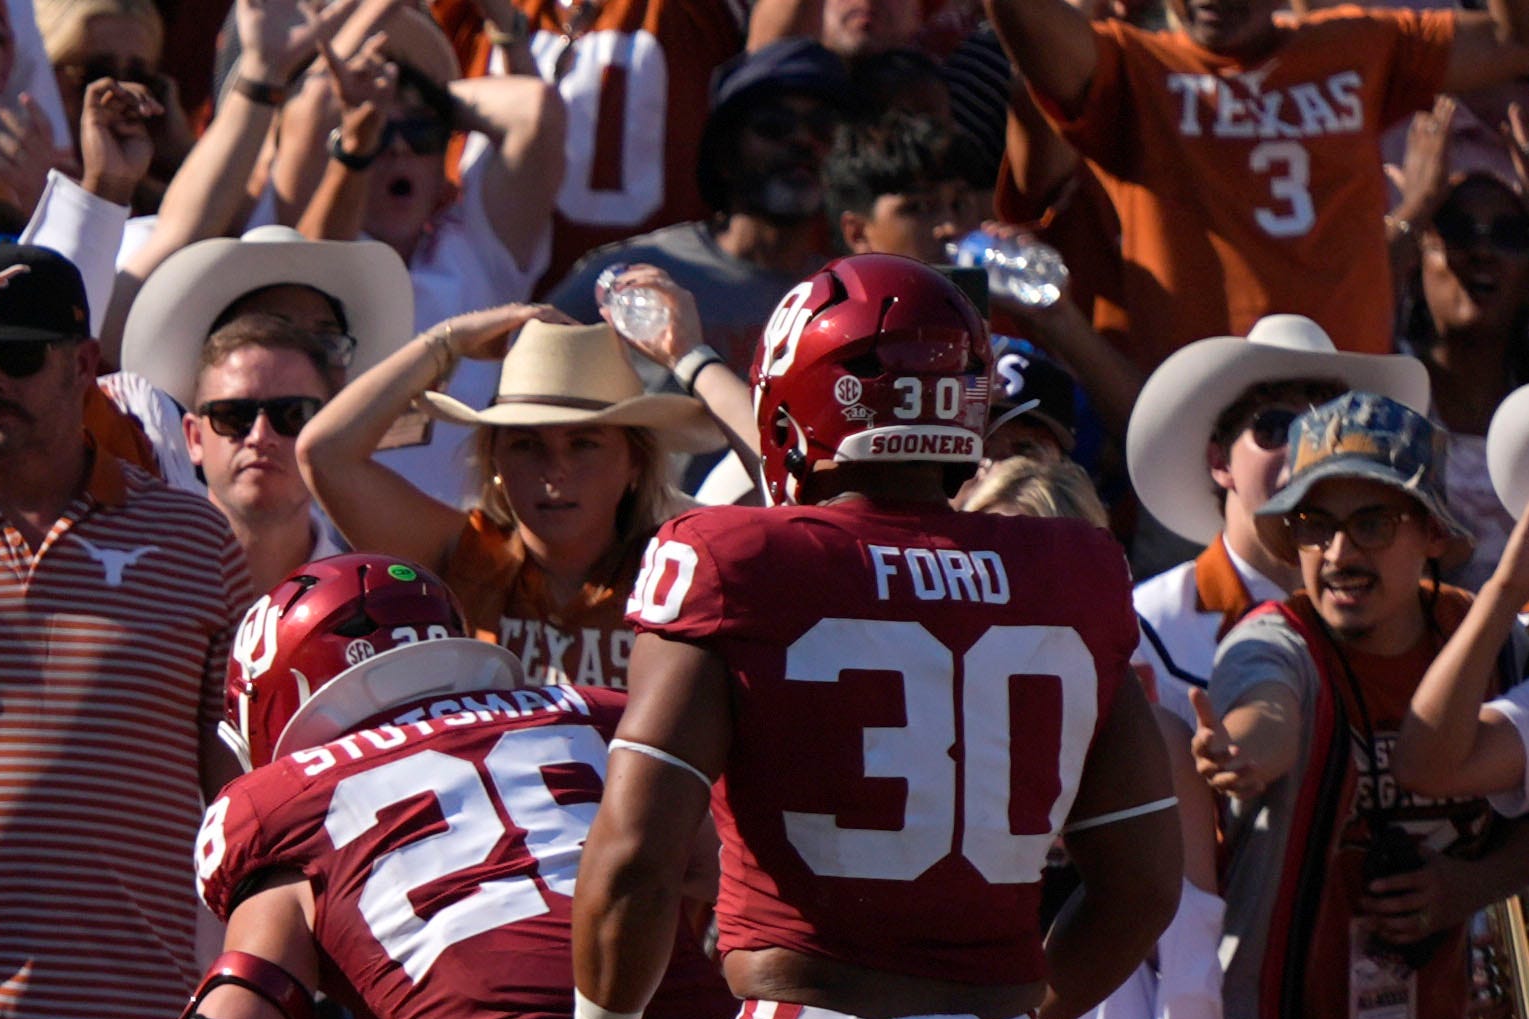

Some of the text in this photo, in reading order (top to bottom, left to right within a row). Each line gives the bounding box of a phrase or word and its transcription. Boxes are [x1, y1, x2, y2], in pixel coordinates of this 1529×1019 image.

[497, 28, 669, 227] 0
[1168, 70, 1363, 138] TEXAS
[1249, 140, 1316, 237] 3
[836, 376, 861, 403] SEC
[892, 376, 959, 420] 30
[872, 434, 975, 455] SOONERS
[868, 544, 1011, 605] FORD
[346, 639, 374, 666] SEC
[499, 615, 635, 689] TEXAS
[291, 683, 591, 777] STUTSMAN
[782, 617, 1099, 885] 30
[194, 795, 231, 910] 8
[323, 723, 610, 986] 28
